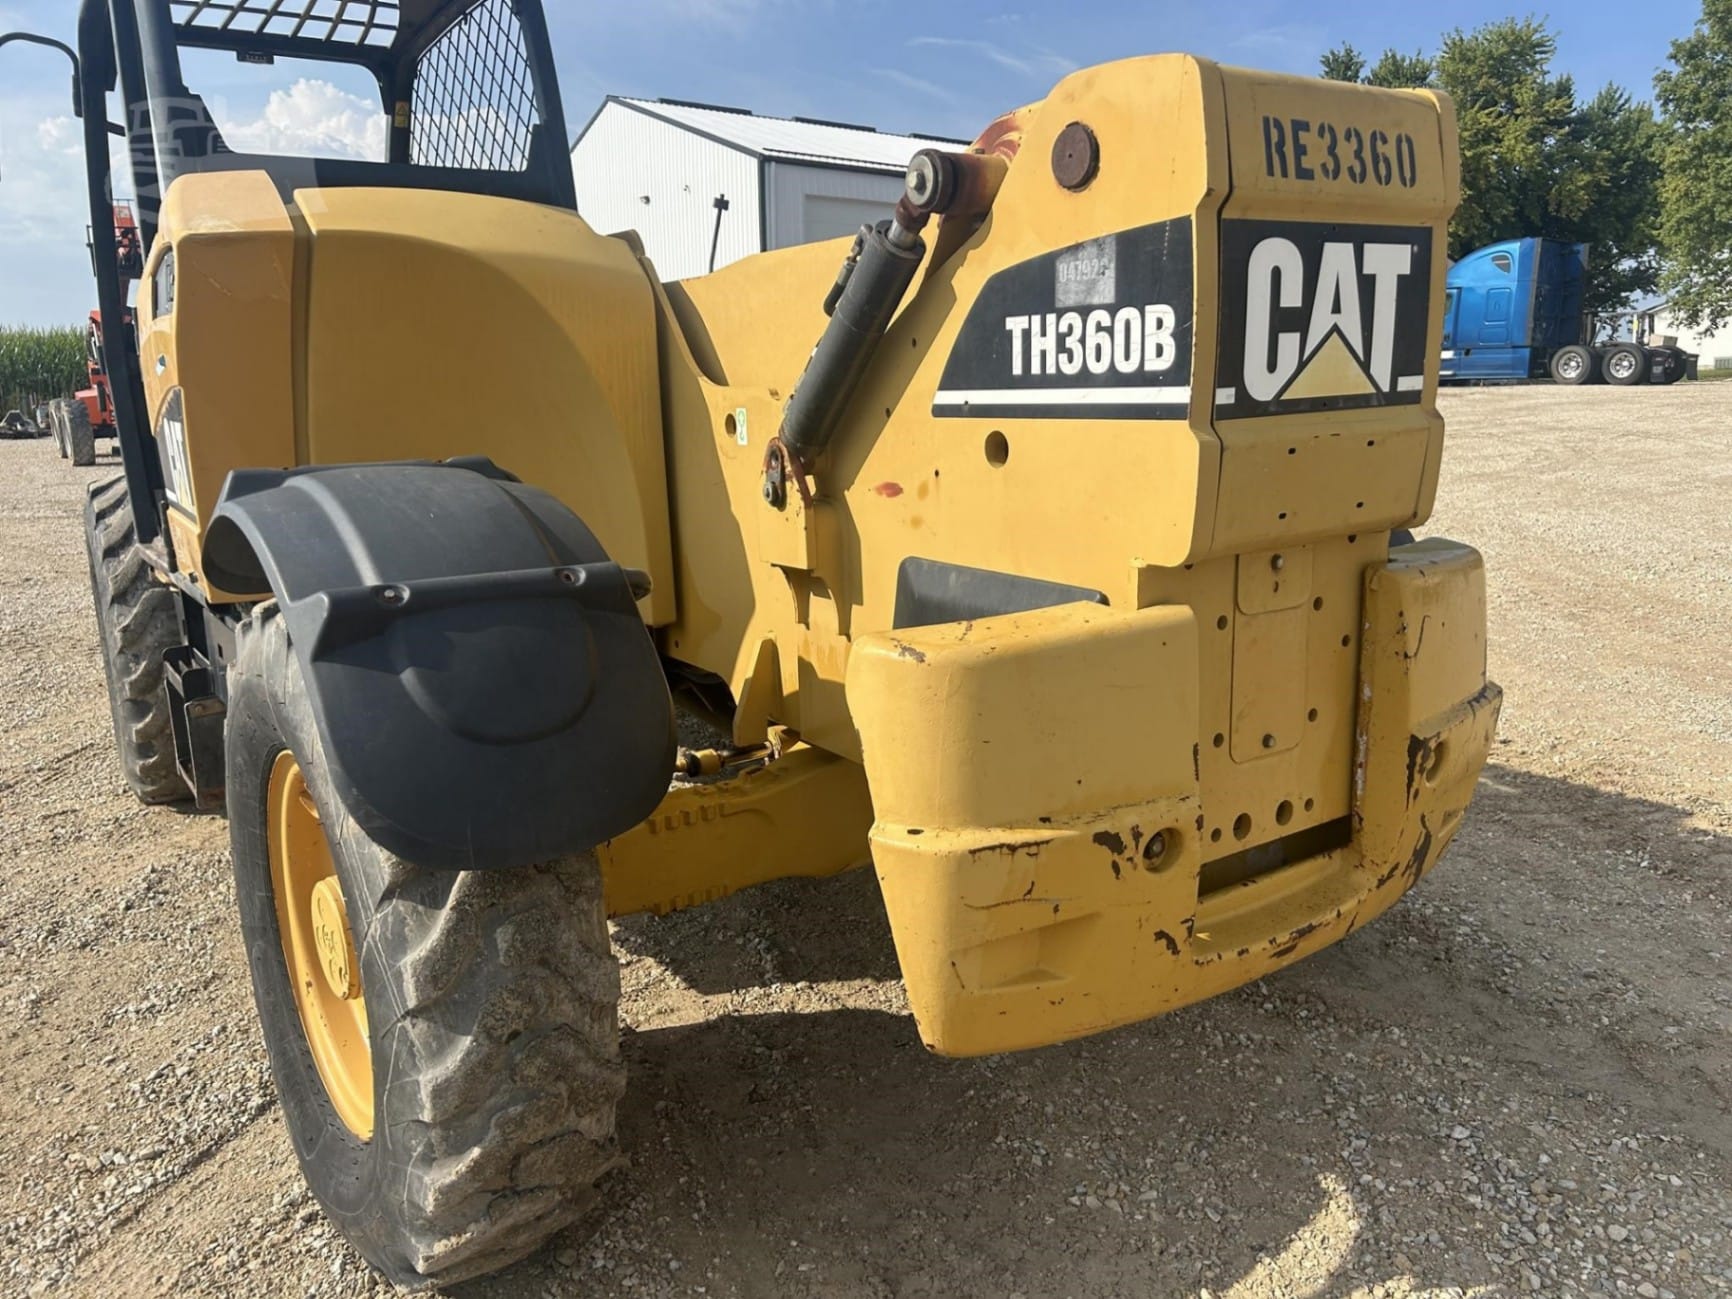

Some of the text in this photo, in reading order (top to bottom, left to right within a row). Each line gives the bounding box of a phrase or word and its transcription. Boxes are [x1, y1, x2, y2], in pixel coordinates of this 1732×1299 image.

[1262, 115, 1416, 188] RE3360
[1005, 304, 1175, 375] TH360B
[1243, 237, 1411, 401] CAT
